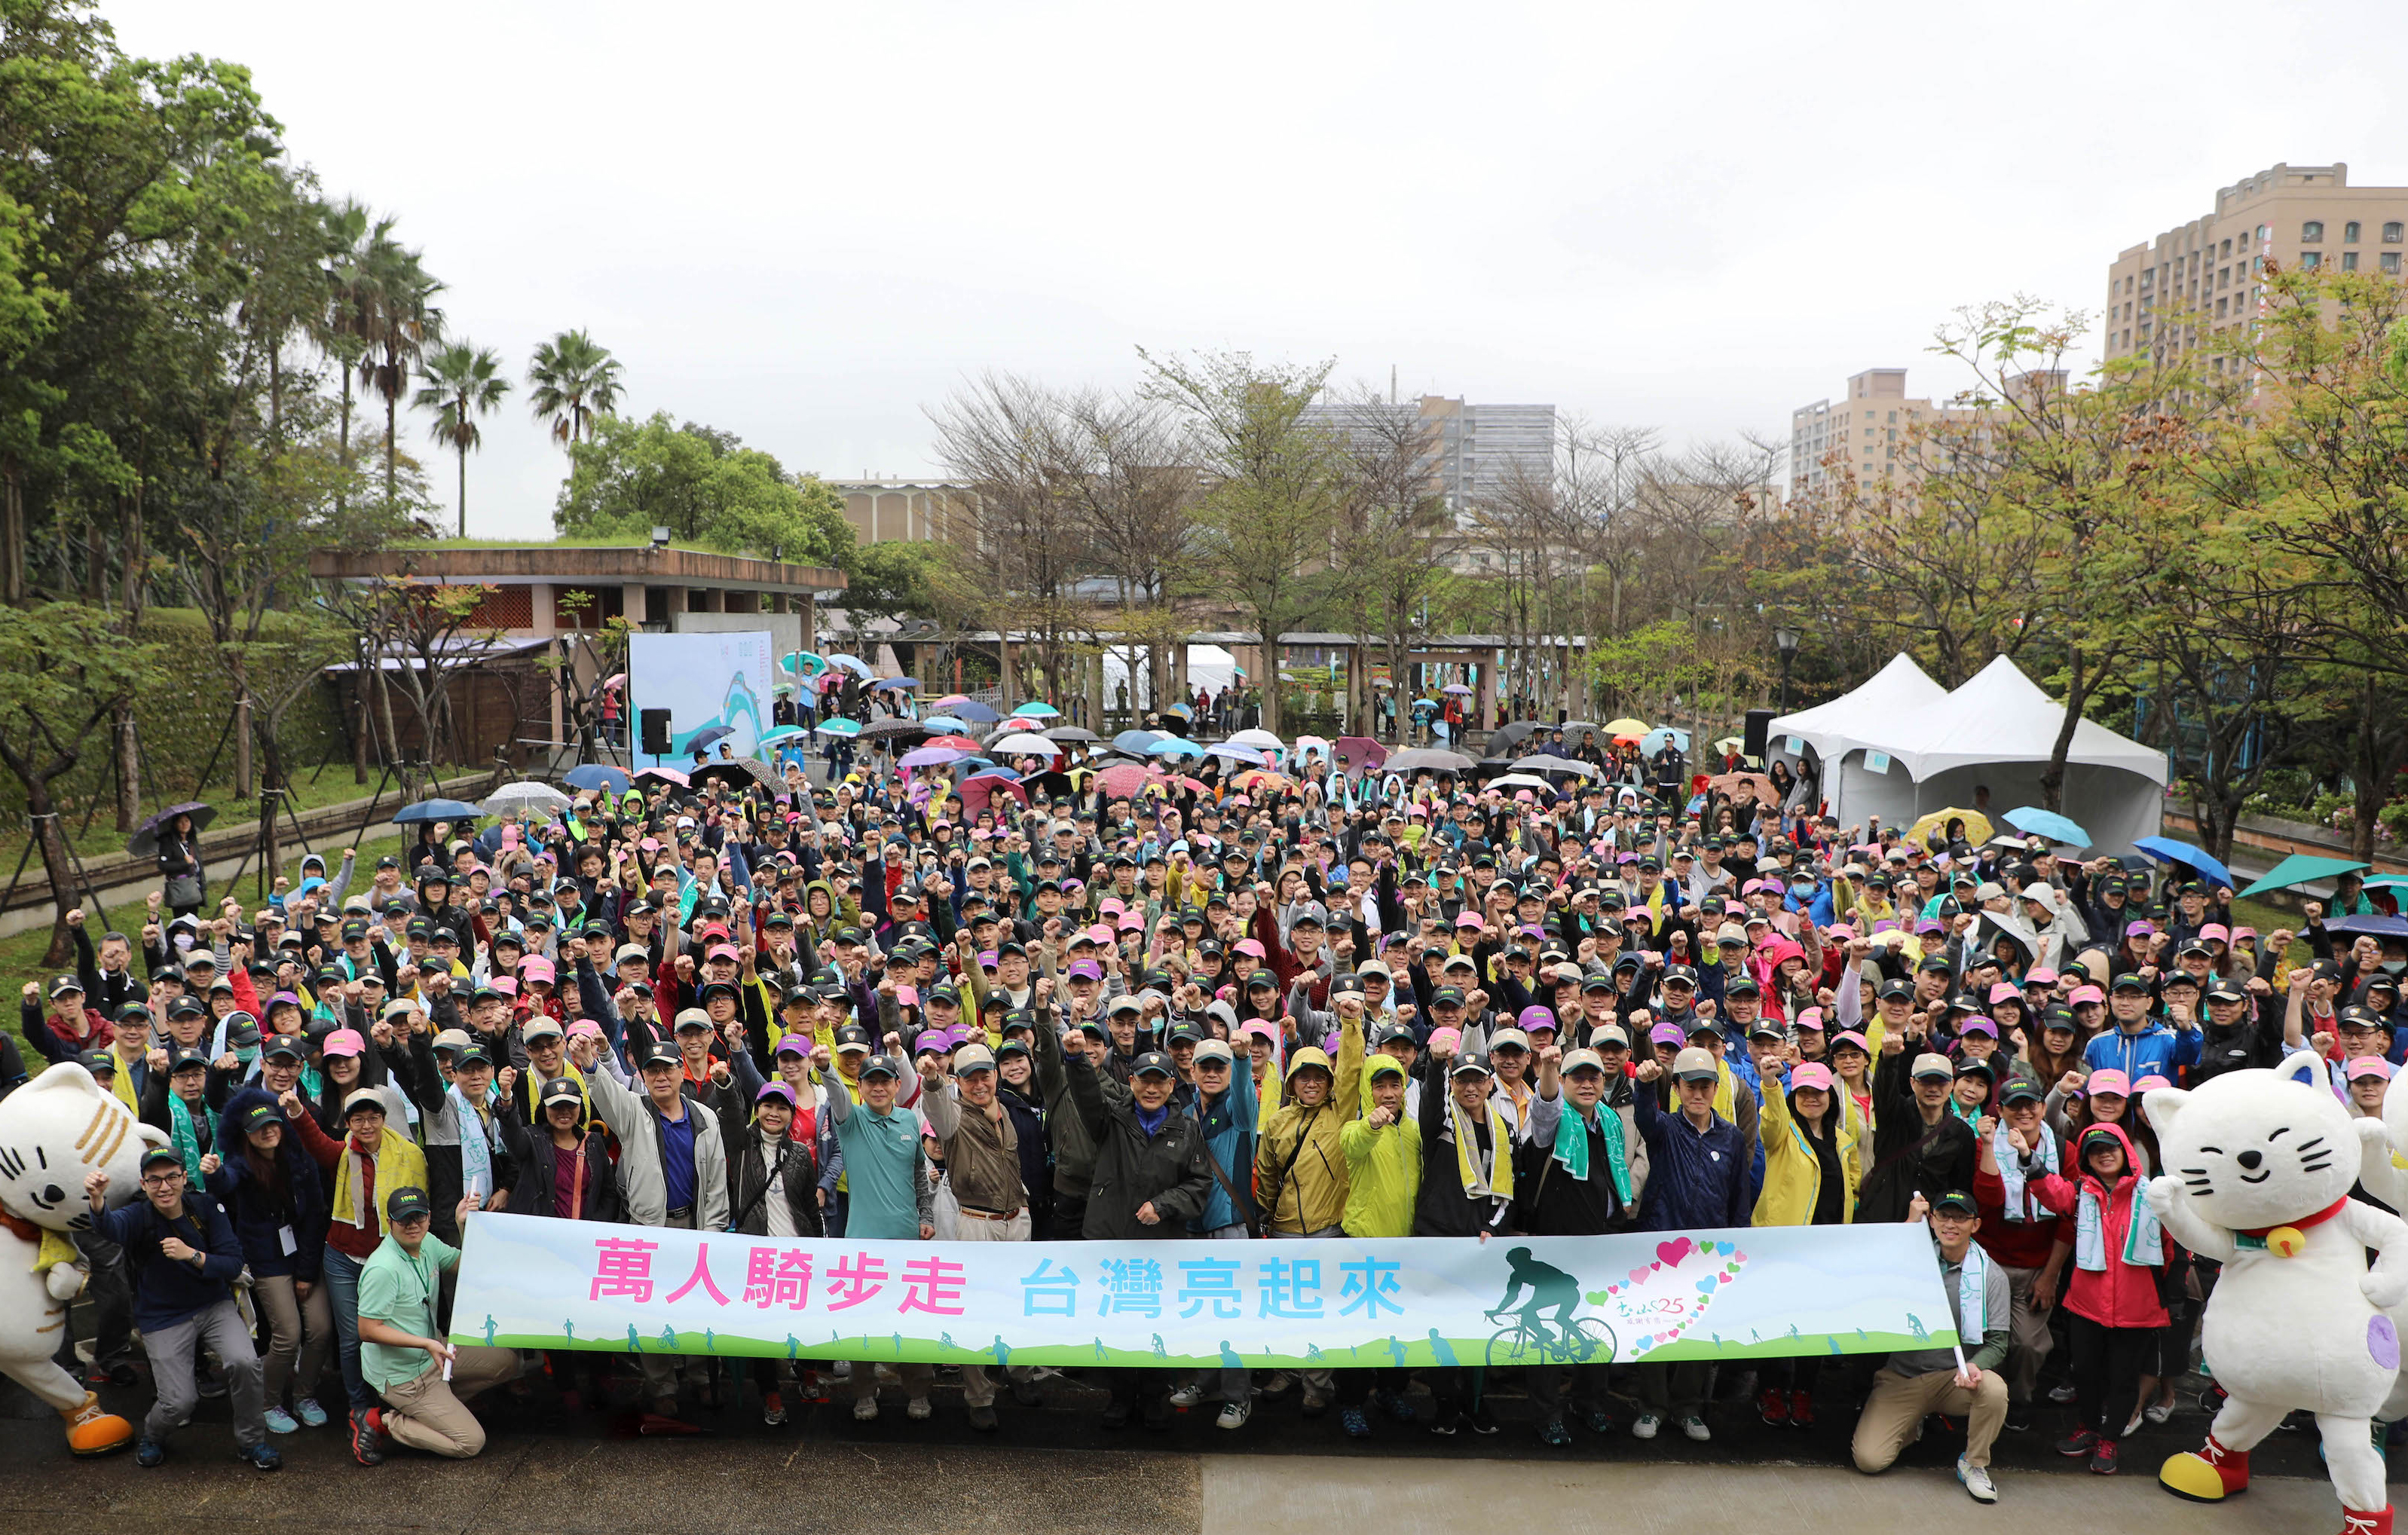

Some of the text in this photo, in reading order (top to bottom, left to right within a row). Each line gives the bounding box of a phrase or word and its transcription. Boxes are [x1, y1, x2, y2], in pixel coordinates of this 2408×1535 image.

[589, 1237, 1405, 1319] 萬人騎步走 台灣亮起來
[1658, 1298, 1684, 1314] 25
